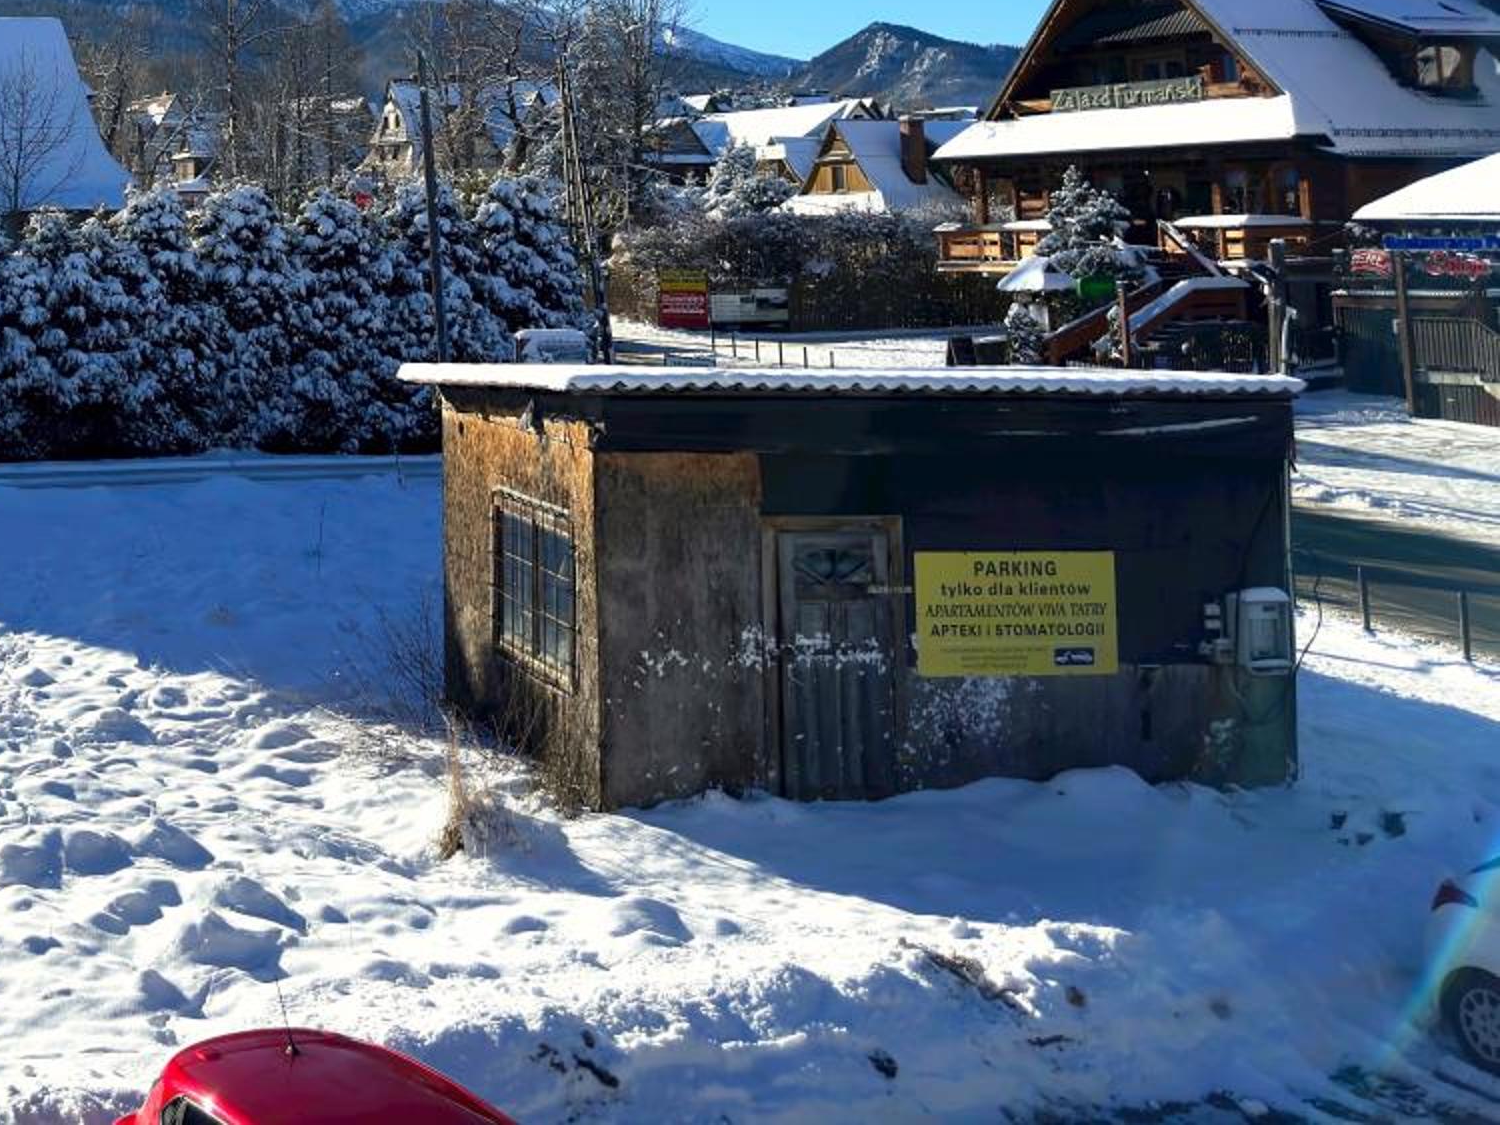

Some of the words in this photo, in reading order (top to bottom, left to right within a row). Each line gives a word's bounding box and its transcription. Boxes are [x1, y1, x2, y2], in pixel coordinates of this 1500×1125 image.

[1051, 85, 1111, 112] Zajazd
[973, 560, 1057, 576] PARKING
[941, 582, 983, 598] tylko
[988, 581, 1014, 596] dla
[1038, 602, 1066, 617] VIVA
[1070, 602, 1107, 617] TATRY
[931, 624, 981, 636] APTEKI
[995, 622, 1105, 636] STOMATOLOGII
